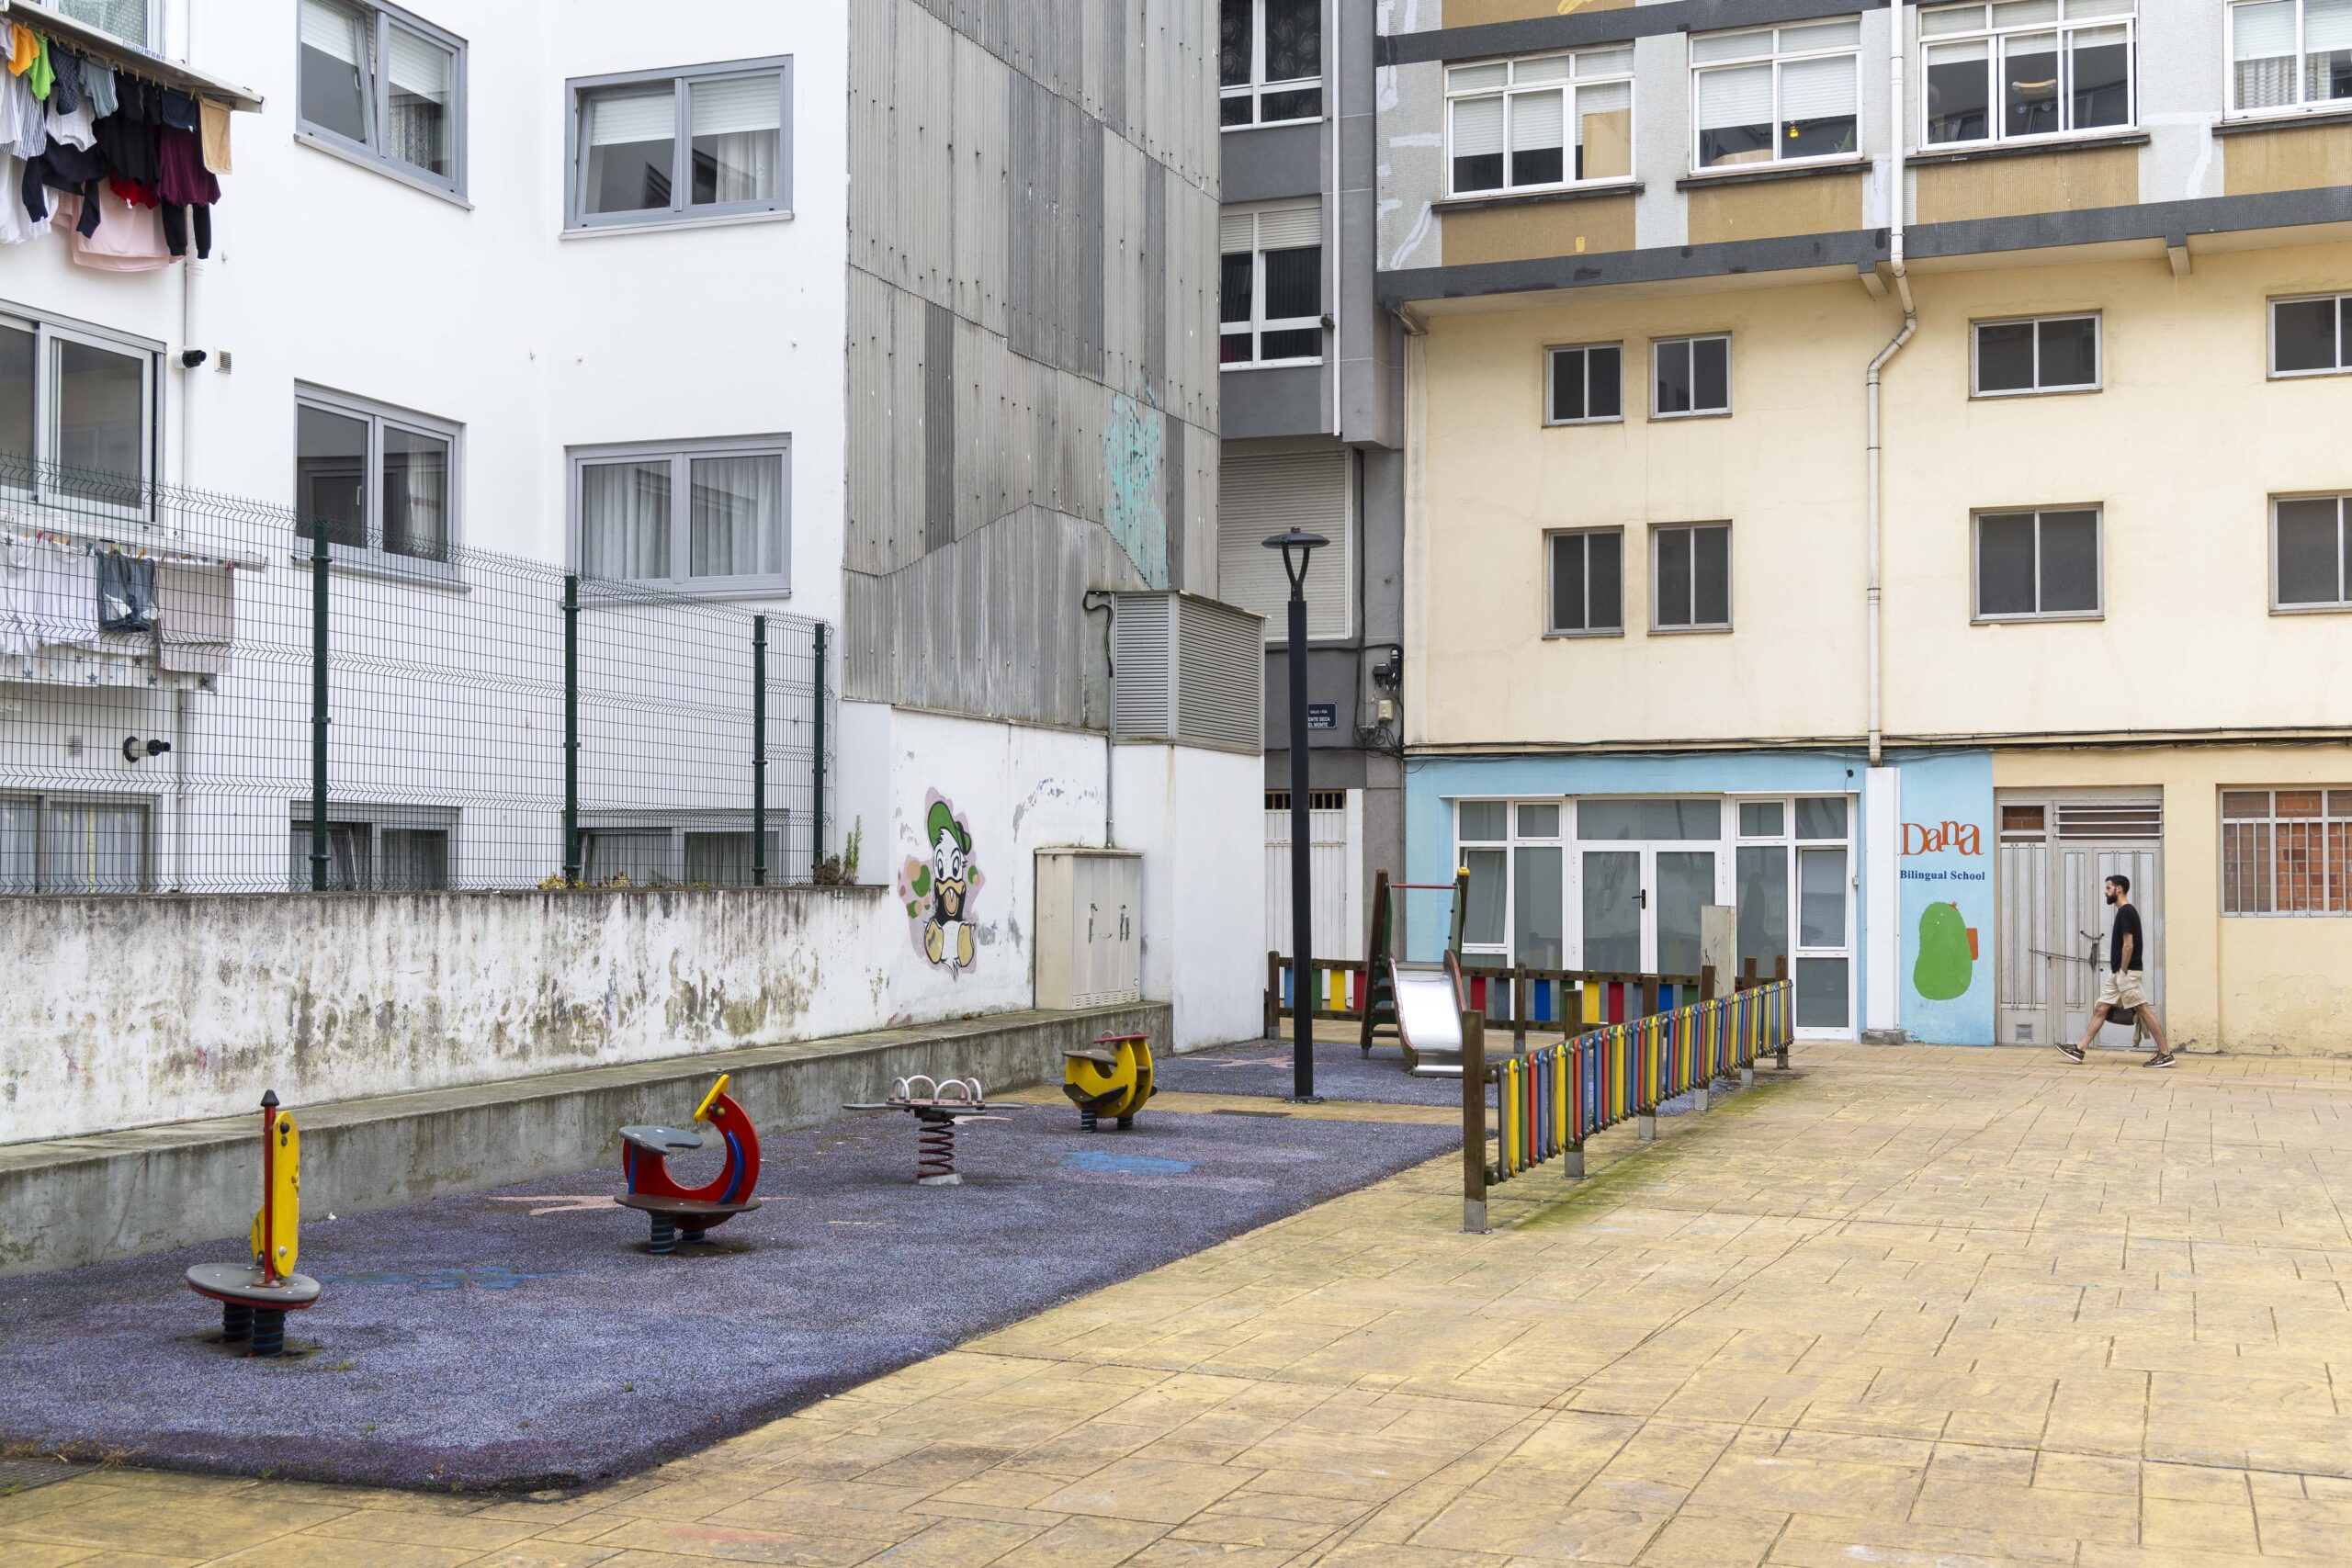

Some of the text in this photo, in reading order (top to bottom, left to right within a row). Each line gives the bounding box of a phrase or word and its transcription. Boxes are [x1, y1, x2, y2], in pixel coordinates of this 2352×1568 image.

[1900, 820, 1984, 856] Dana
[1900, 870, 1985, 882] Bilingual School
